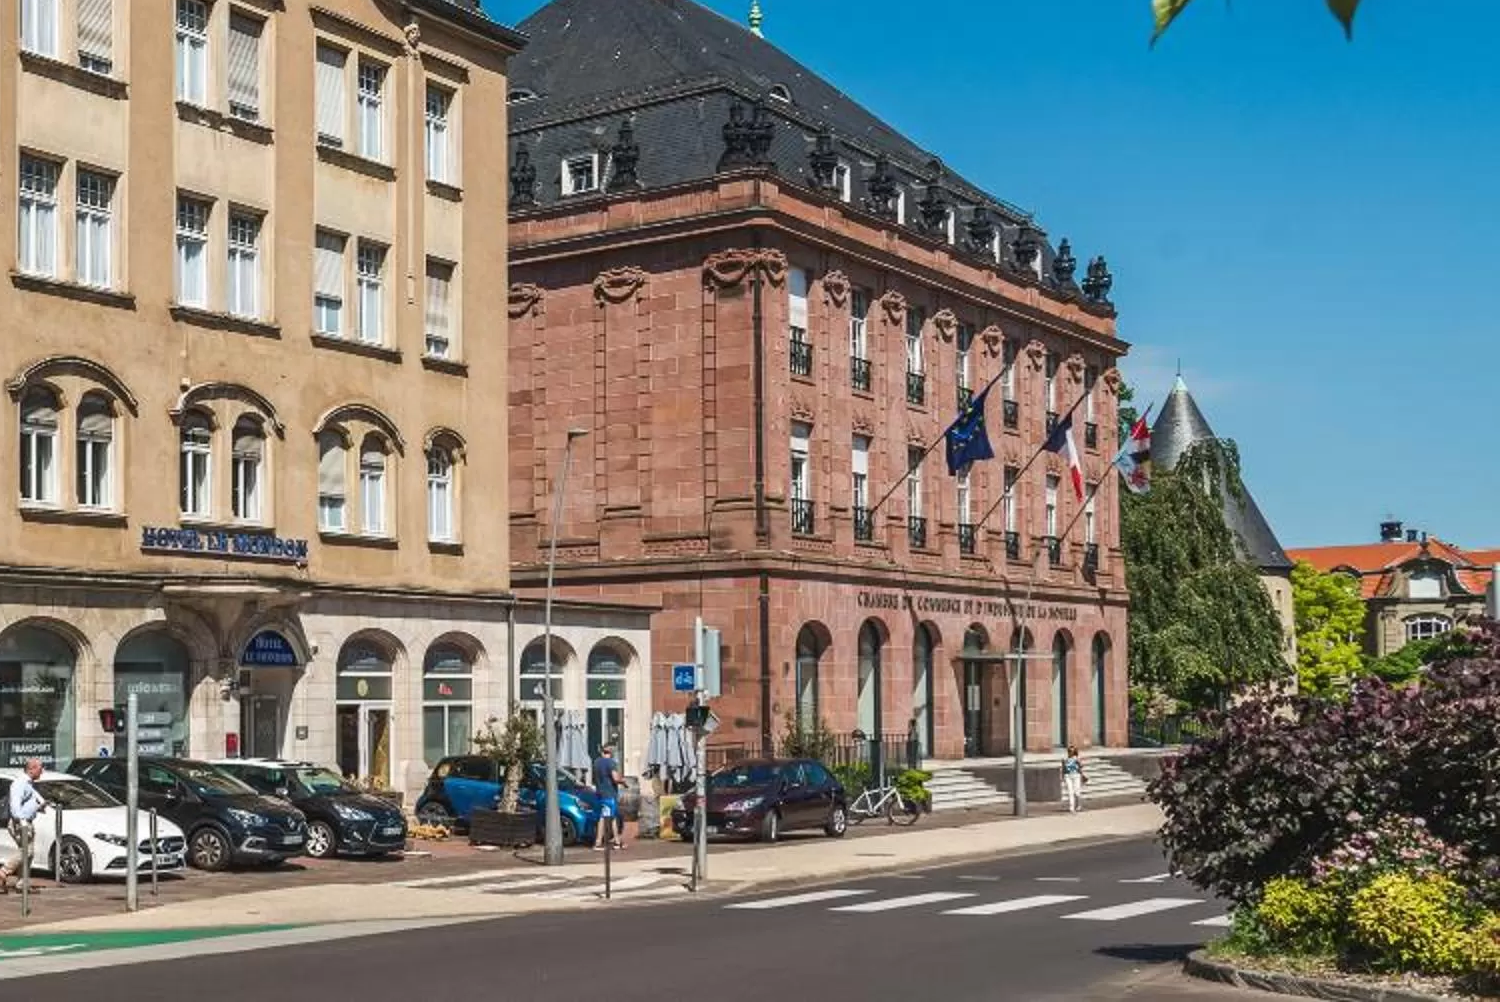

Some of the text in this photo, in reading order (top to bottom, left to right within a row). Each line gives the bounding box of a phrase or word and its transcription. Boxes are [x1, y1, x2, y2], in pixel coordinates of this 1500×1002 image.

[207, 531, 229, 551] LE
[857, 592, 899, 611] CHAMBRE
[917, 597, 961, 615] COMMERCE
